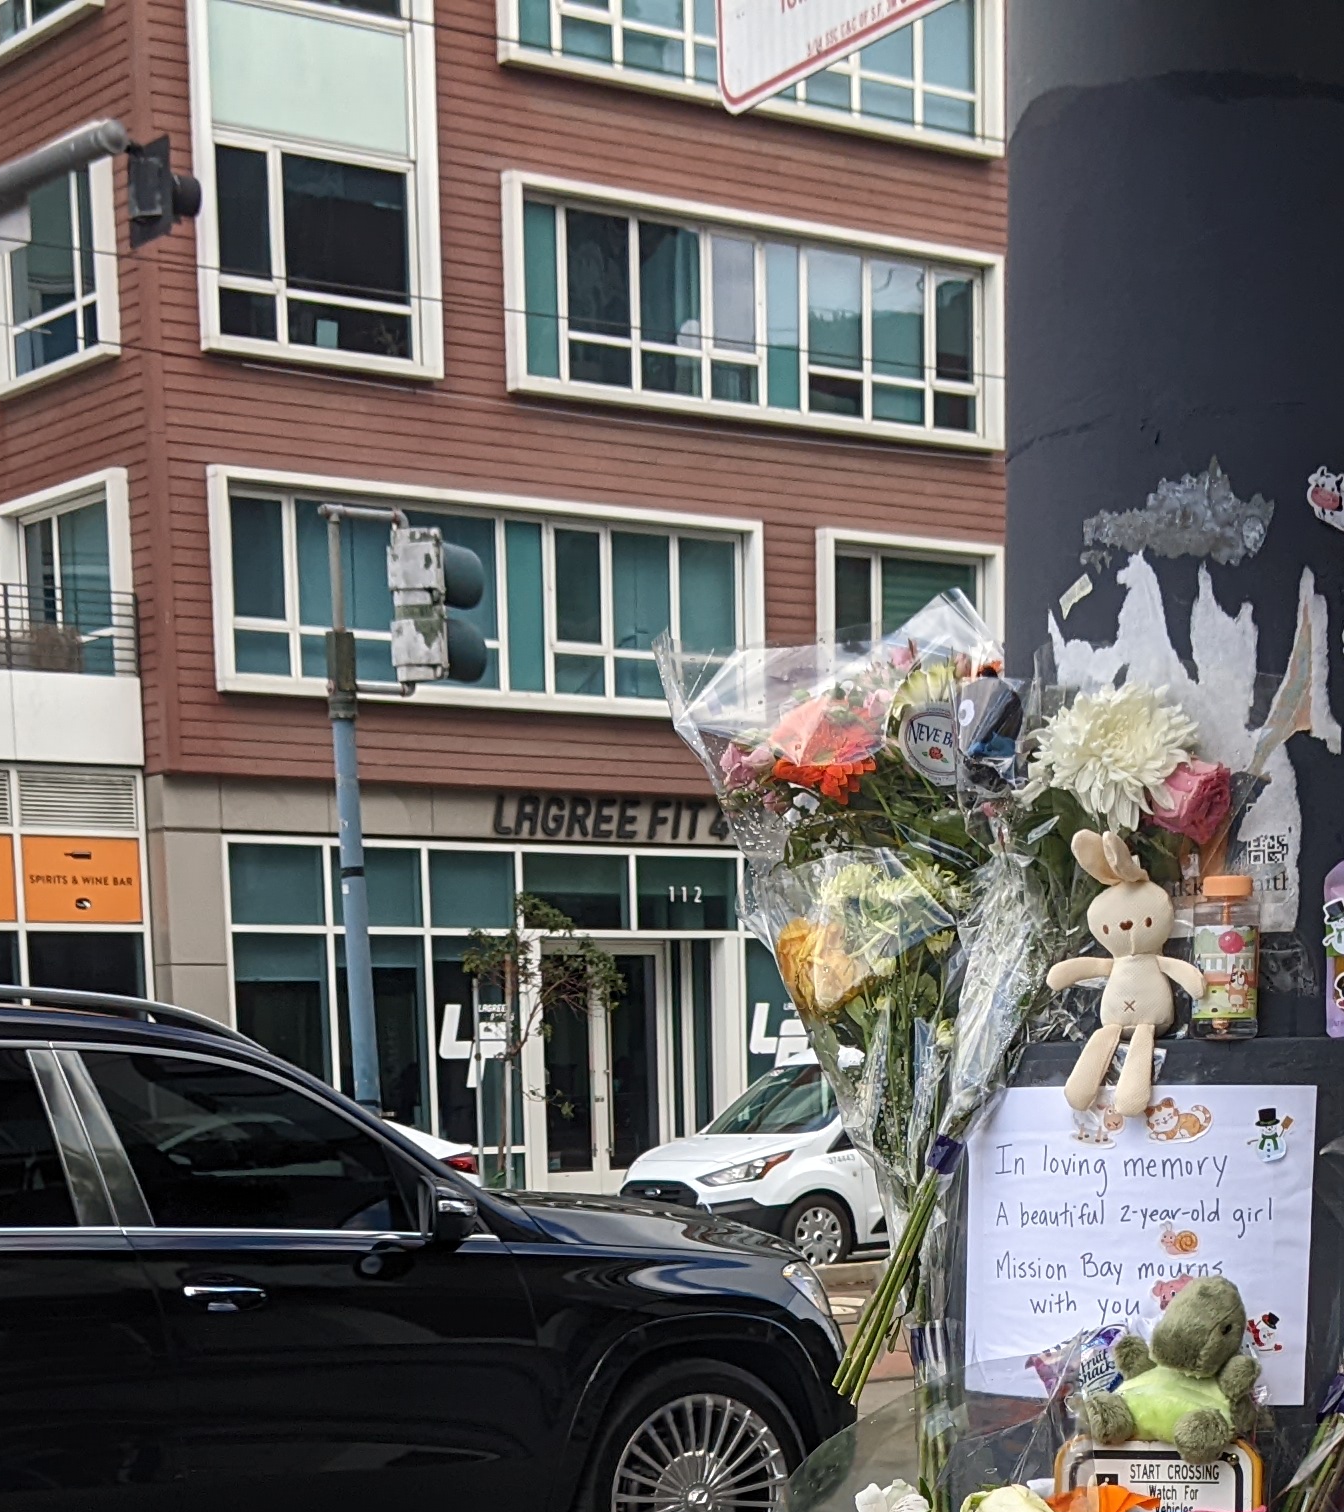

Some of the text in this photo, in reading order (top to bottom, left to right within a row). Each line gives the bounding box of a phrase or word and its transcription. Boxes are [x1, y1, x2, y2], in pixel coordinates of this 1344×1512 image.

[908, 719, 942, 744] NEVE
[493, 795, 641, 840] LAGREE
[647, 800, 707, 840] FIT
[29, 874, 133, 886] SPIRITS & WINE BAR
[668, 886, 703, 904] 112
[996, 1144, 1227, 1196] In loving memory
[996, 1200, 1273, 1239] A beautiful 2-year-old girl
[996, 1252, 1223, 1285] Mission Bay mourns
[1030, 1292, 1141, 1326] with you
[1130, 1464, 1220, 1480] START CROSSING
[1149, 1485, 1199, 1500] Watch For
